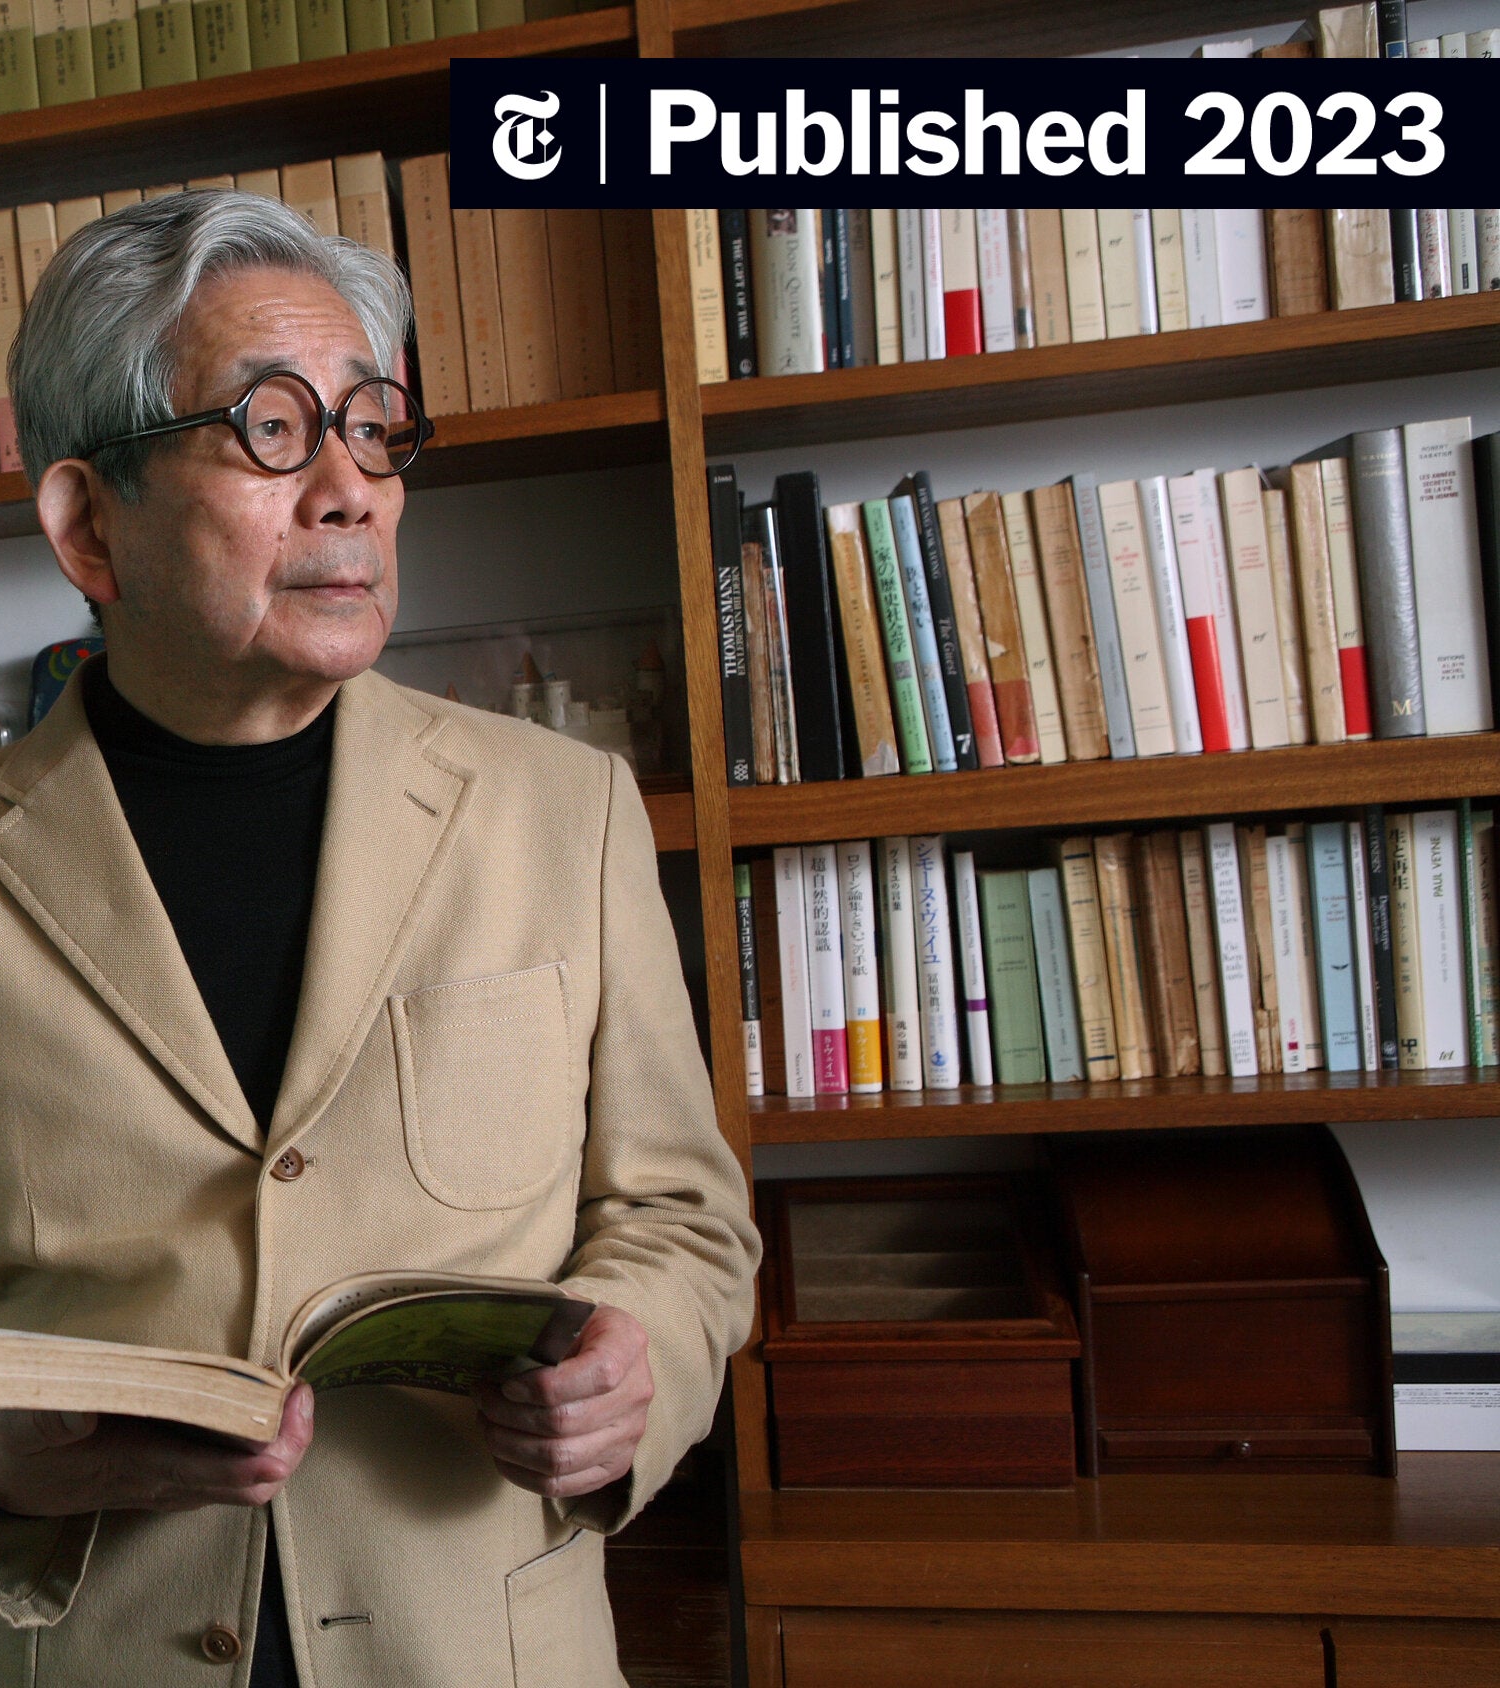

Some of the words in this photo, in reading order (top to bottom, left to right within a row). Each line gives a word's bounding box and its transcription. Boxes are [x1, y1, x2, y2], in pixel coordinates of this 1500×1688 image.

[717, 566, 732, 611] MANN
[721, 612, 738, 678] THOMAS
[938, 617, 951, 639] The
[942, 641, 958, 676] Guest
[1392, 698, 1413, 717] M
[956, 733, 971, 754] 7
[1432, 835, 1442, 863] VEYNE
[1433, 866, 1444, 898] PAUL
[810, 857, 832, 952] 超自然的認識
[915, 842, 942, 965] シモーヌ・ヴェイユ
[738, 899, 753, 970] ポストコロニアル
